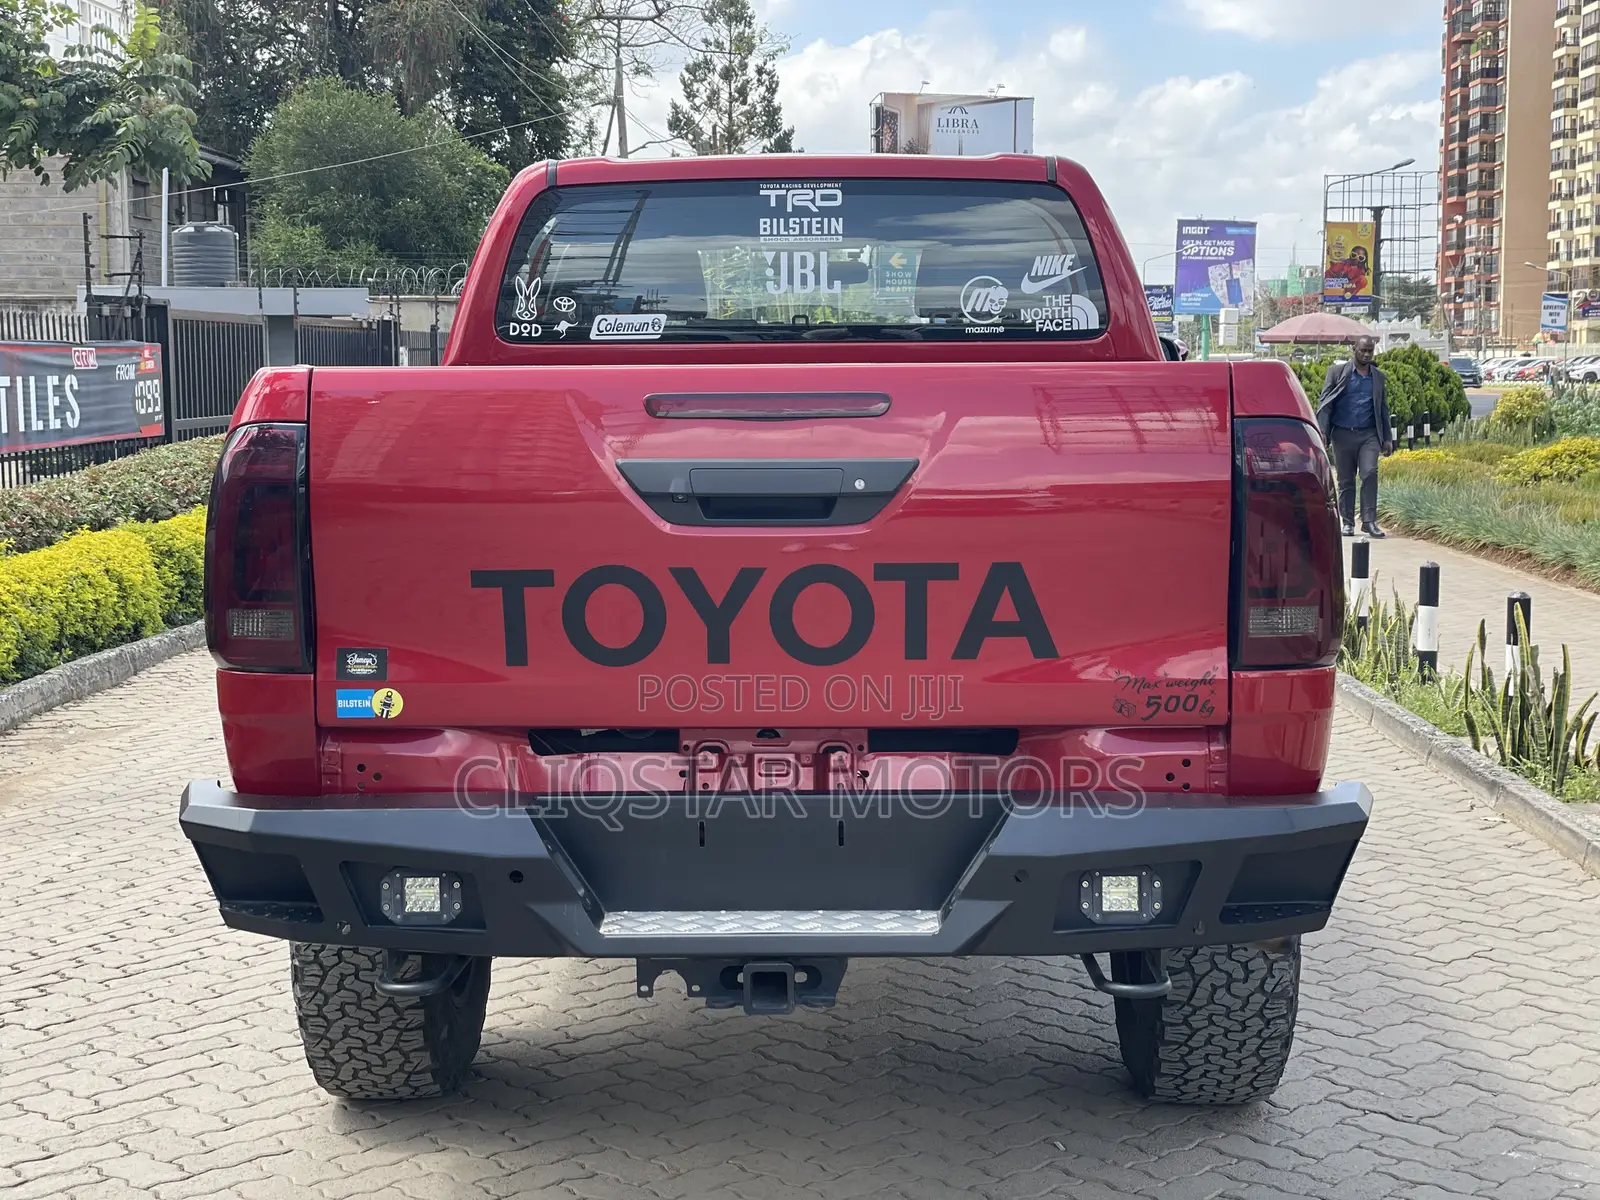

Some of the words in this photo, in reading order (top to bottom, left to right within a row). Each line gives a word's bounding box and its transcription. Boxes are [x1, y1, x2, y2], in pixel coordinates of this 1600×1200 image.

[937, 117, 979, 129] LIBRA
[760, 189, 843, 212] TRD
[760, 217, 843, 235] BILSTEIN
[1182, 226, 1210, 234] INGOT
[1182, 246, 1235, 256] OPTIONS
[765, 251, 841, 294] JBL
[1030, 254, 1076, 276] NIKE
[1042, 294, 1071, 306] THE
[1020, 307, 1072, 320] NORTH
[597, 317, 650, 333] Coleman
[965, 326, 1005, 334] mazume
[1035, 318, 1072, 332] FACE
[115, 364, 136, 380] FROM
[0, 374, 81, 434] TILES
[470, 562, 1060, 667] TOYOTA
[1113, 675, 1161, 694] Max
[1165, 671, 1216, 692] weight
[337, 699, 371, 708] BILSTEIN
